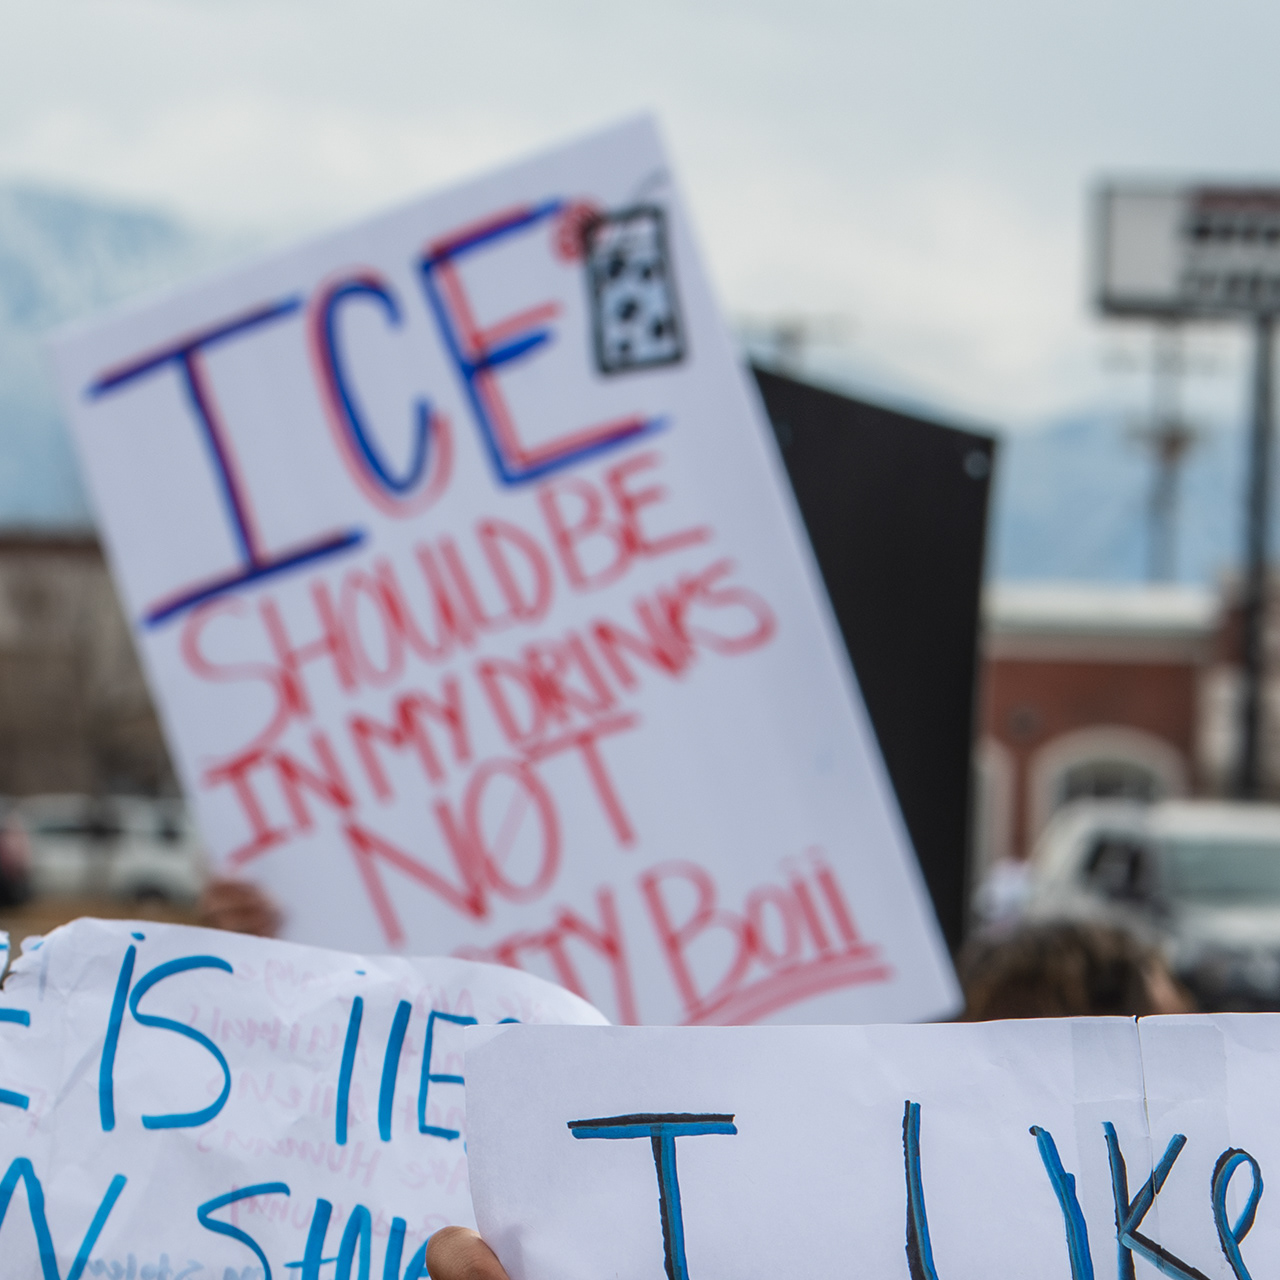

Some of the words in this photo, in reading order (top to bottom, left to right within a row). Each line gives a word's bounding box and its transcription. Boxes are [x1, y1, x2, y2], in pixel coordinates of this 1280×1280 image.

[85, 197, 672, 630] ICE
[178, 512, 556, 757] SHOULD
[538, 452, 713, 597] BE
[201, 730, 358, 868] IN
[346, 672, 476, 806] MY
[476, 556, 780, 750] DRINKS
[342, 708, 644, 952] NOT
[99, 931, 234, 1132] IS
